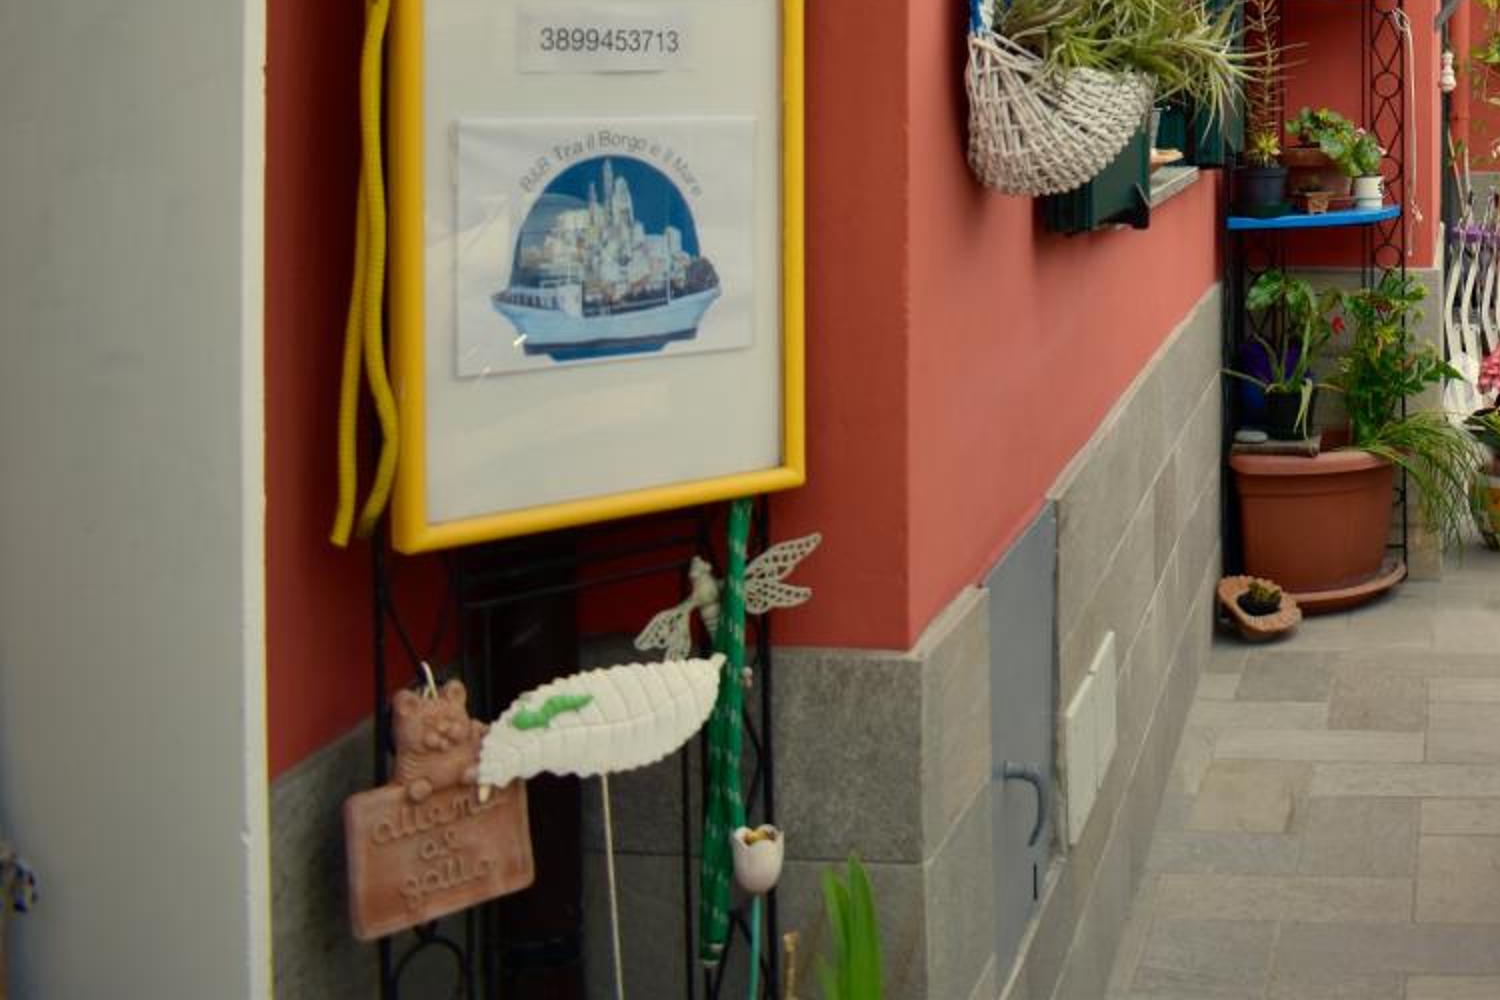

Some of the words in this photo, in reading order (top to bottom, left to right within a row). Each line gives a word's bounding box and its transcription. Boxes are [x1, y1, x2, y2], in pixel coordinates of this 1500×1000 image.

[540, 27, 679, 52] 3899453713
[553, 140, 583, 161] Tra
[599, 130, 648, 153] Borgo
